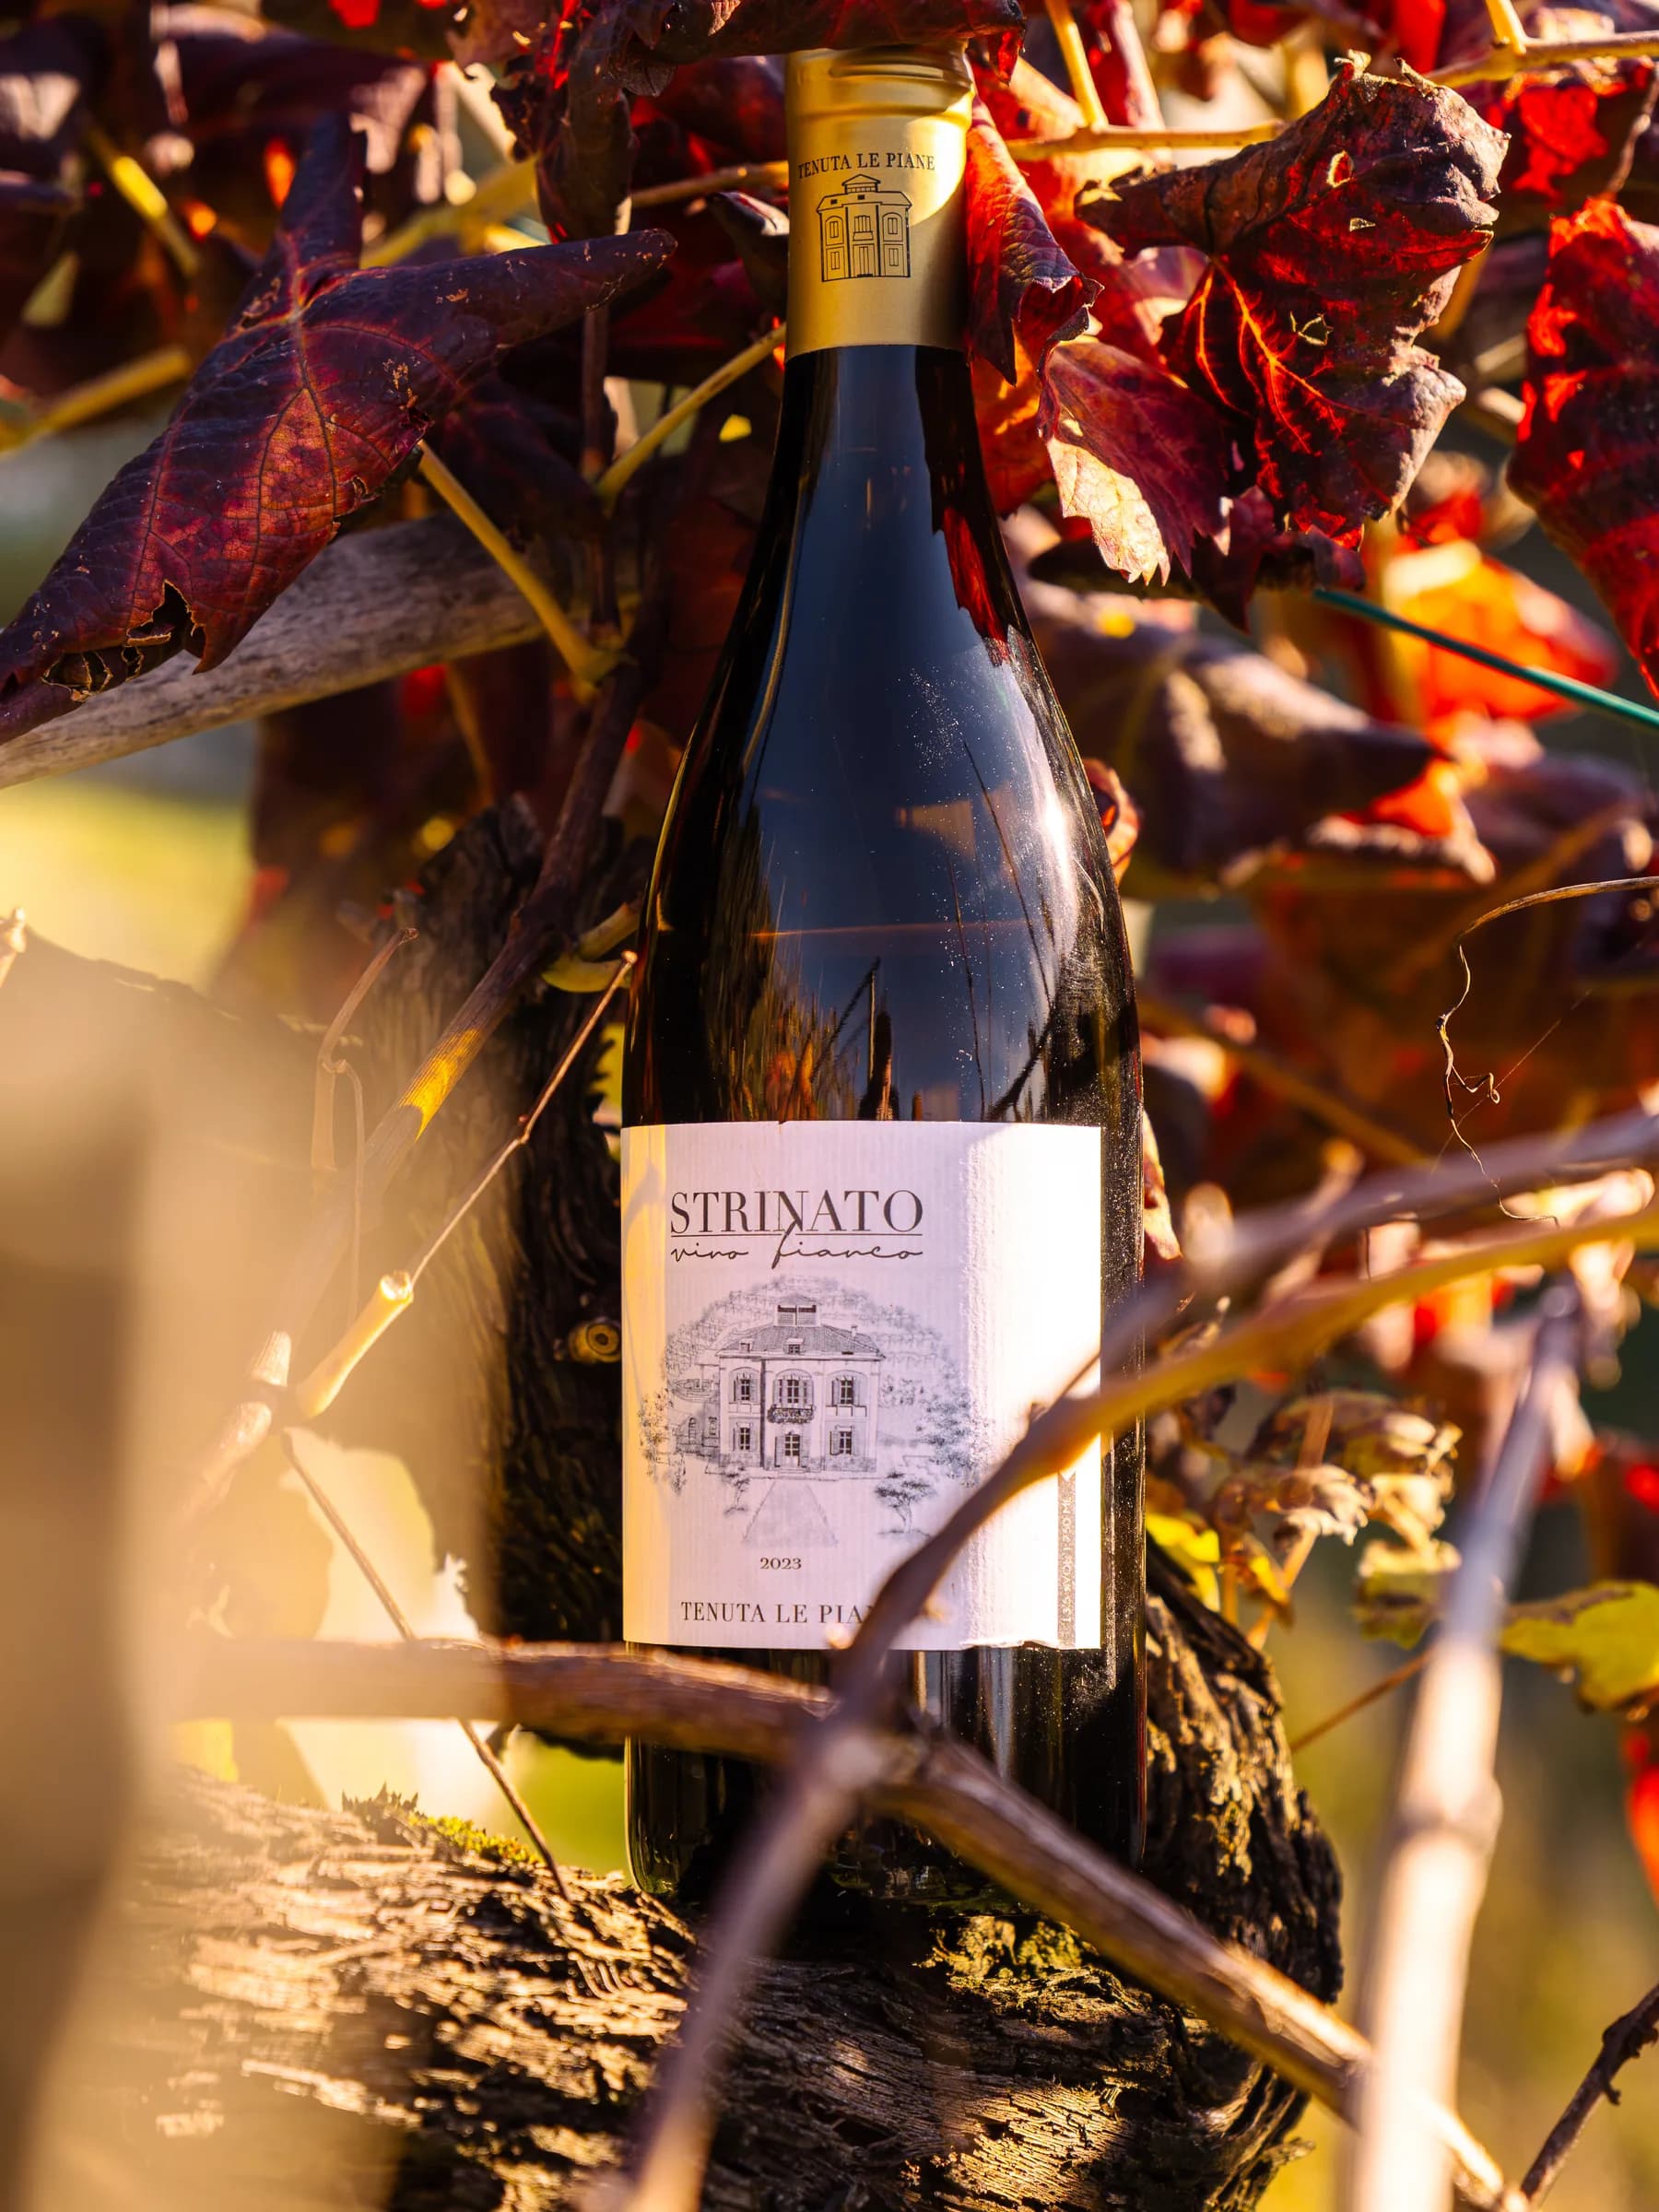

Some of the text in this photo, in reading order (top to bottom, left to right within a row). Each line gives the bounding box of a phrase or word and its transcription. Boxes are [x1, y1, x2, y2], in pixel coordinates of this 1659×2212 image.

[797, 152, 935, 179] TENUTA LE PIANE
[670, 1189, 924, 1233] STRINATO
[670, 1242, 749, 1263] vino
[759, 1557, 802, 1571] 2023
[681, 1601, 874, 1624] TENUTA LE PIA
